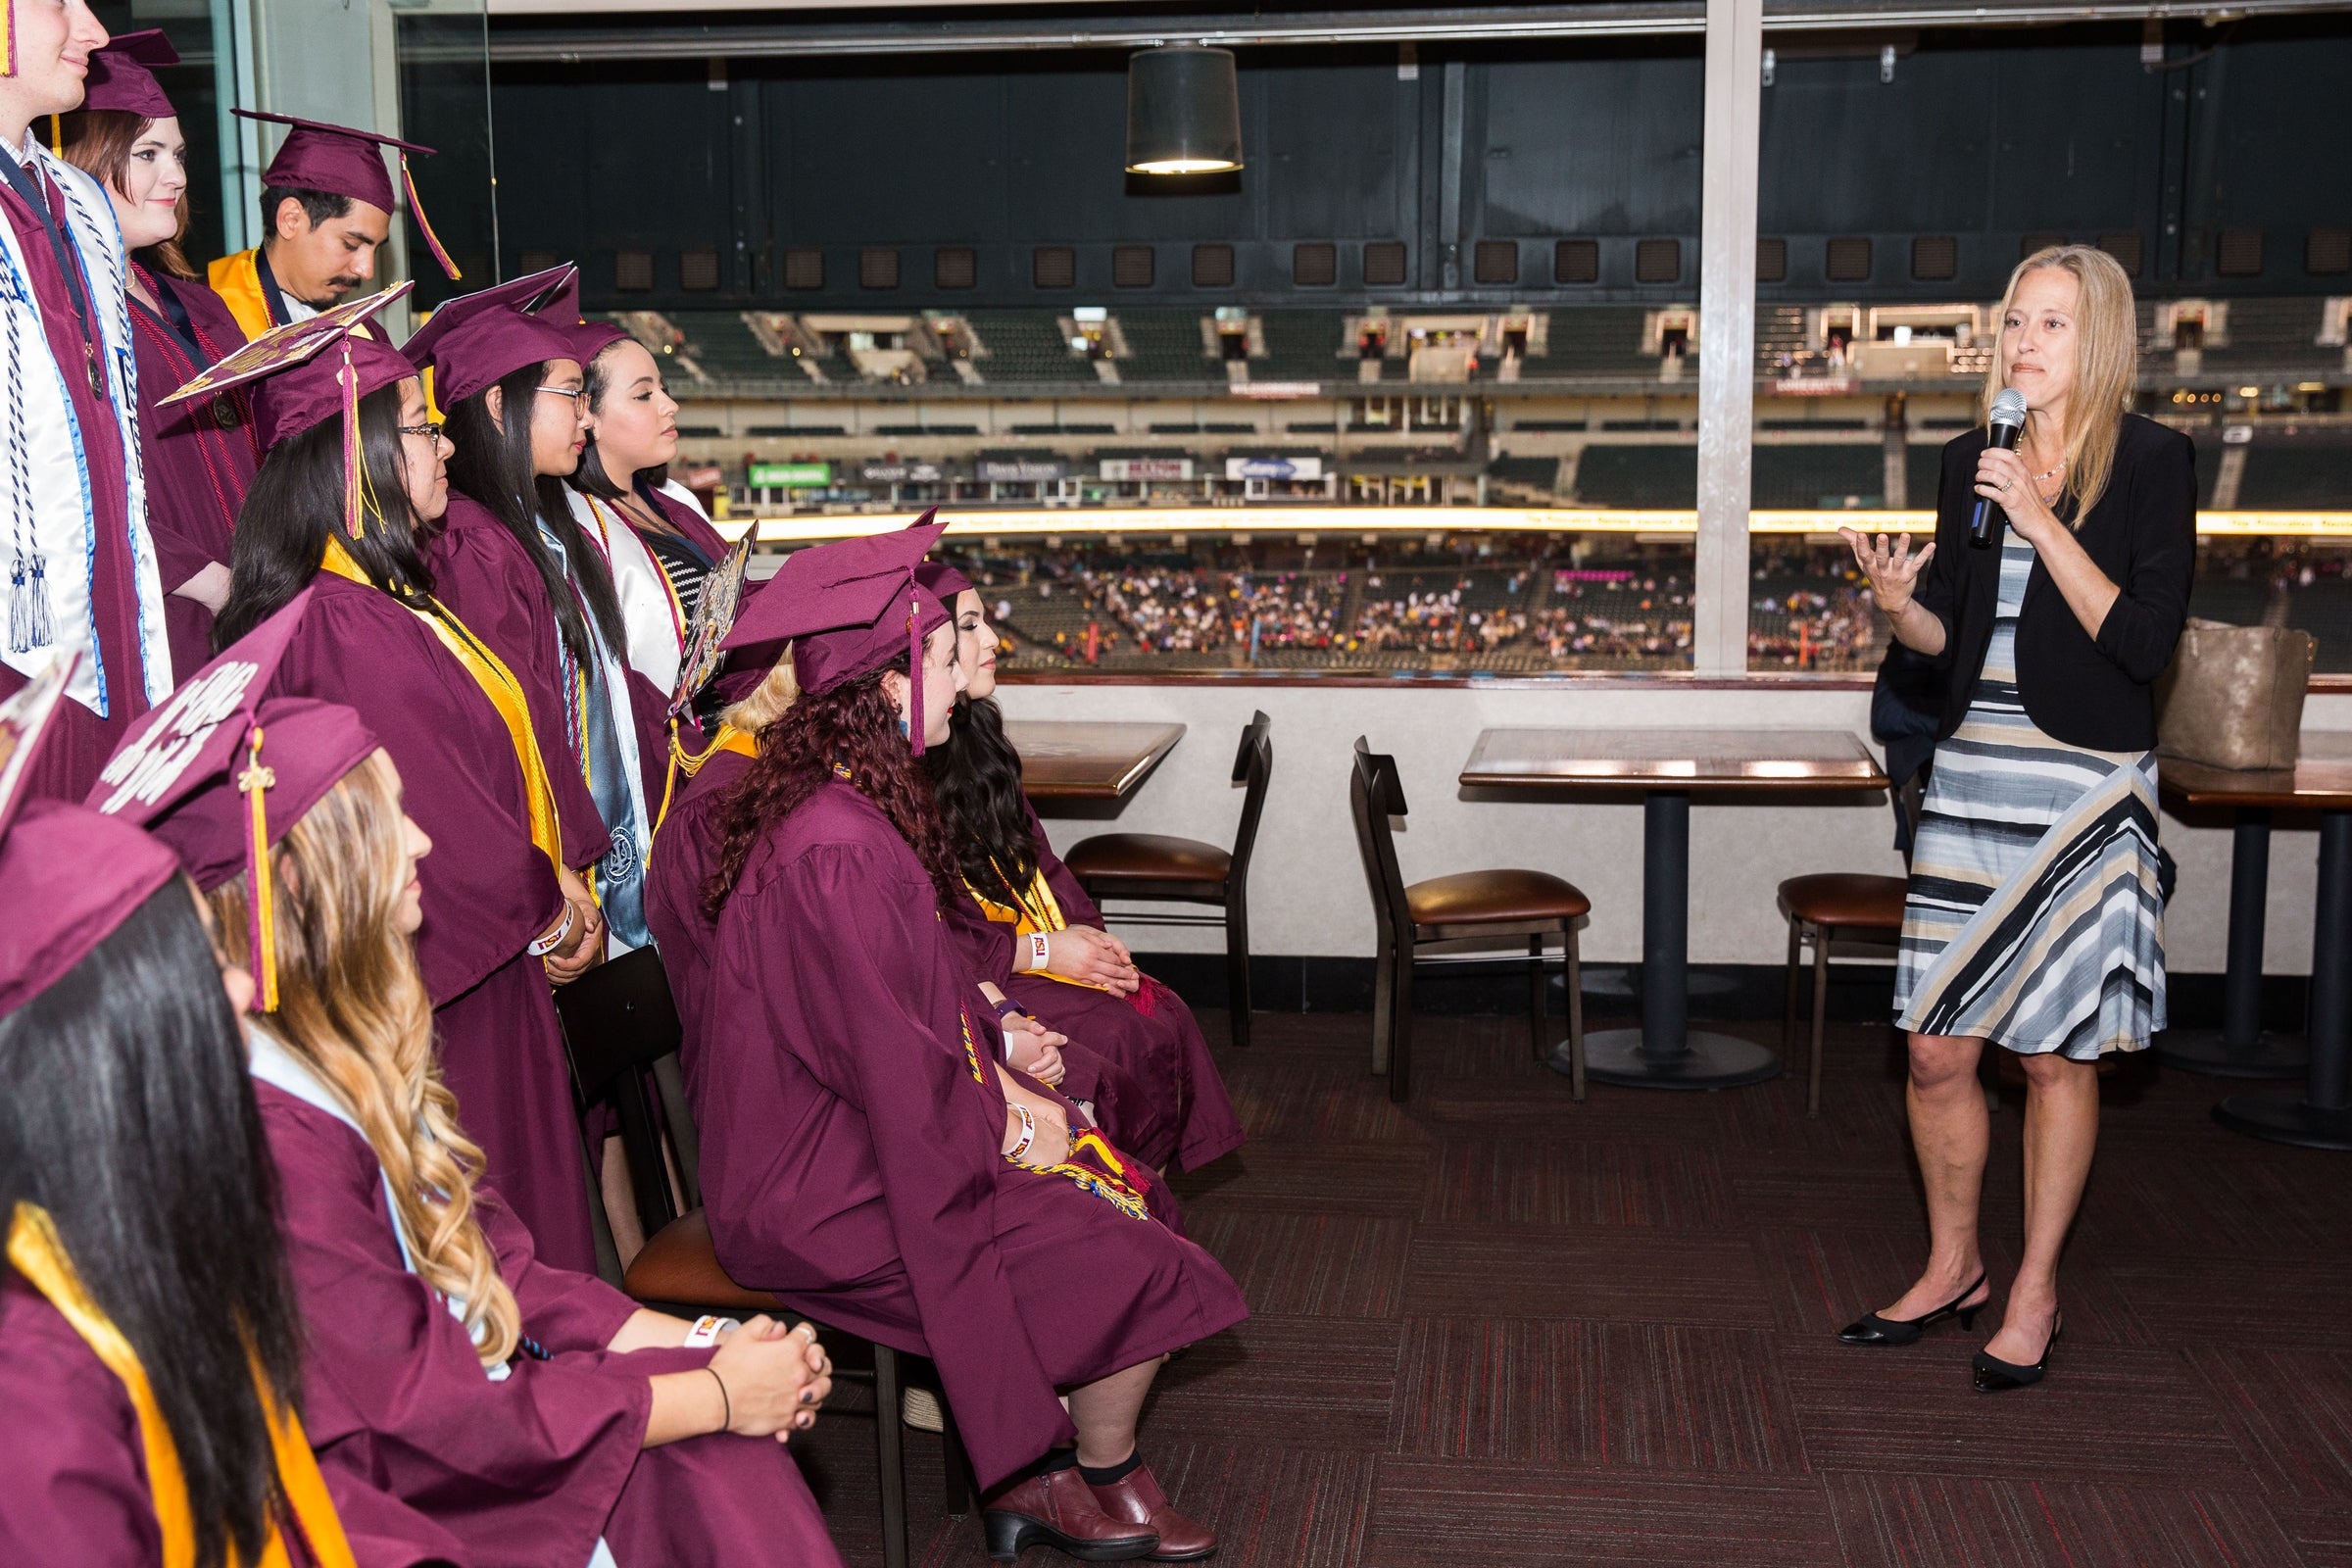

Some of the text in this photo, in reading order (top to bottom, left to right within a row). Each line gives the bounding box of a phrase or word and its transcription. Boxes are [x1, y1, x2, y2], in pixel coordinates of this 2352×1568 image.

[537, 929, 562, 951] ASU
[1034, 937, 1046, 956] ASU
[1009, 1138, 1030, 1158] ASU
